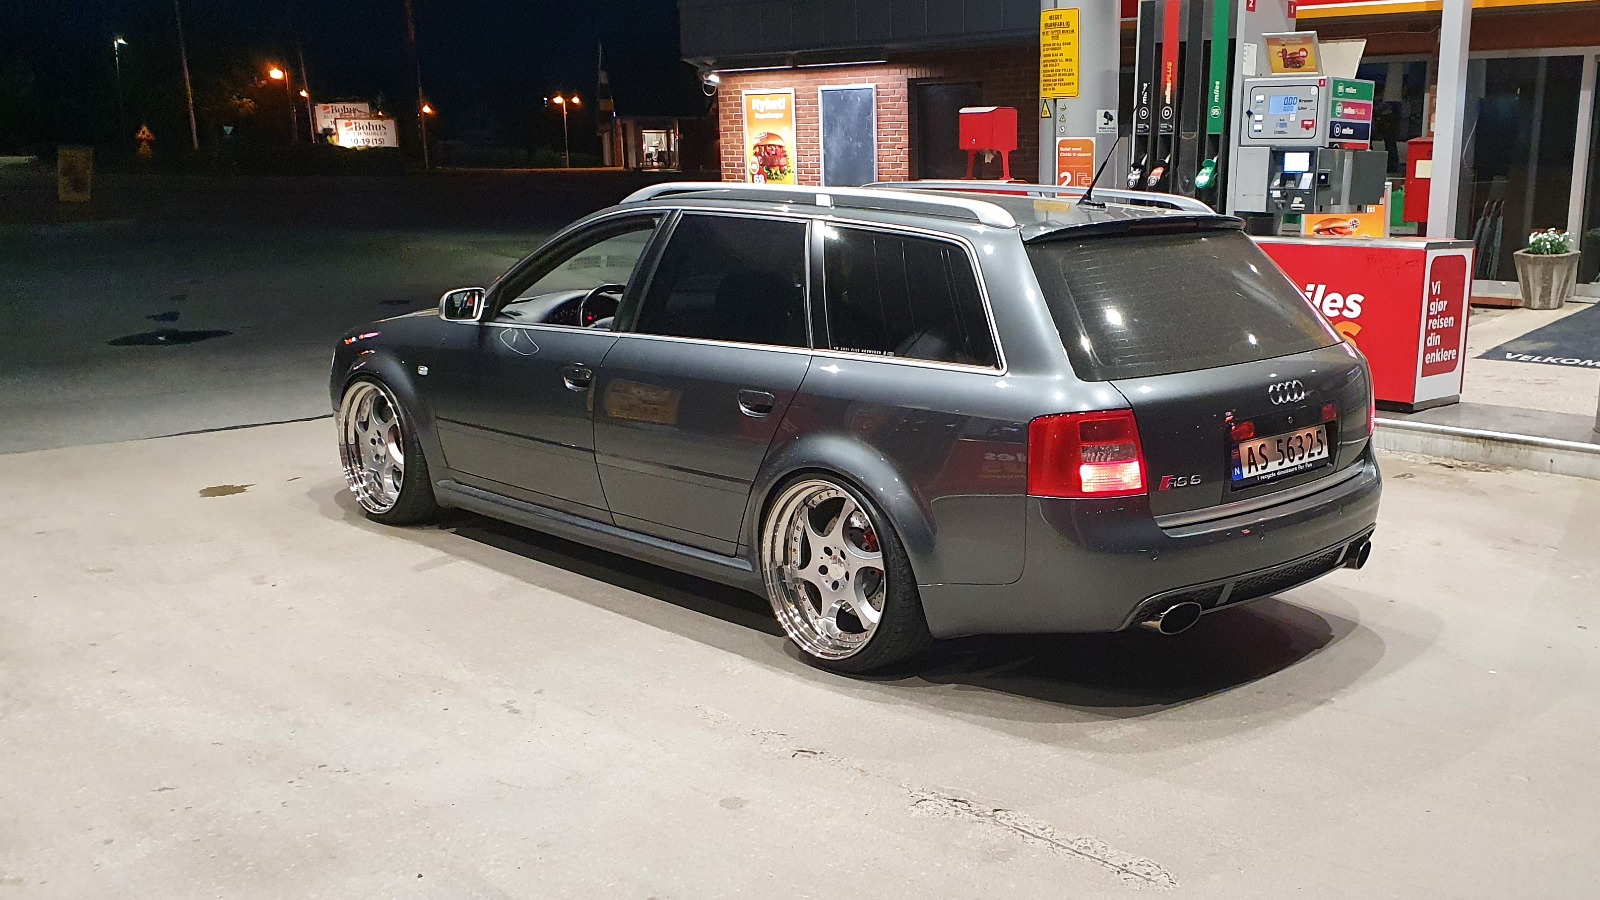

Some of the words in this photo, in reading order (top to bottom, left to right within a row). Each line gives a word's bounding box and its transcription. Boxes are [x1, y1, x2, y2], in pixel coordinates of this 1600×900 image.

[354, 121, 387, 132] Bohus
[1431, 280, 1441, 295] Vi
[1304, 284, 1365, 318] iles
[1429, 298, 1448, 315] gjør
[1428, 315, 1454, 330] reisen
[1426, 332, 1441, 347] din
[1425, 348, 1457, 365] enklere
[1248, 443, 1269, 474] AS
[1276, 430, 1324, 466] 56325
[1234, 467, 1241, 475] N
[1260, 472, 1276, 480] recycle
